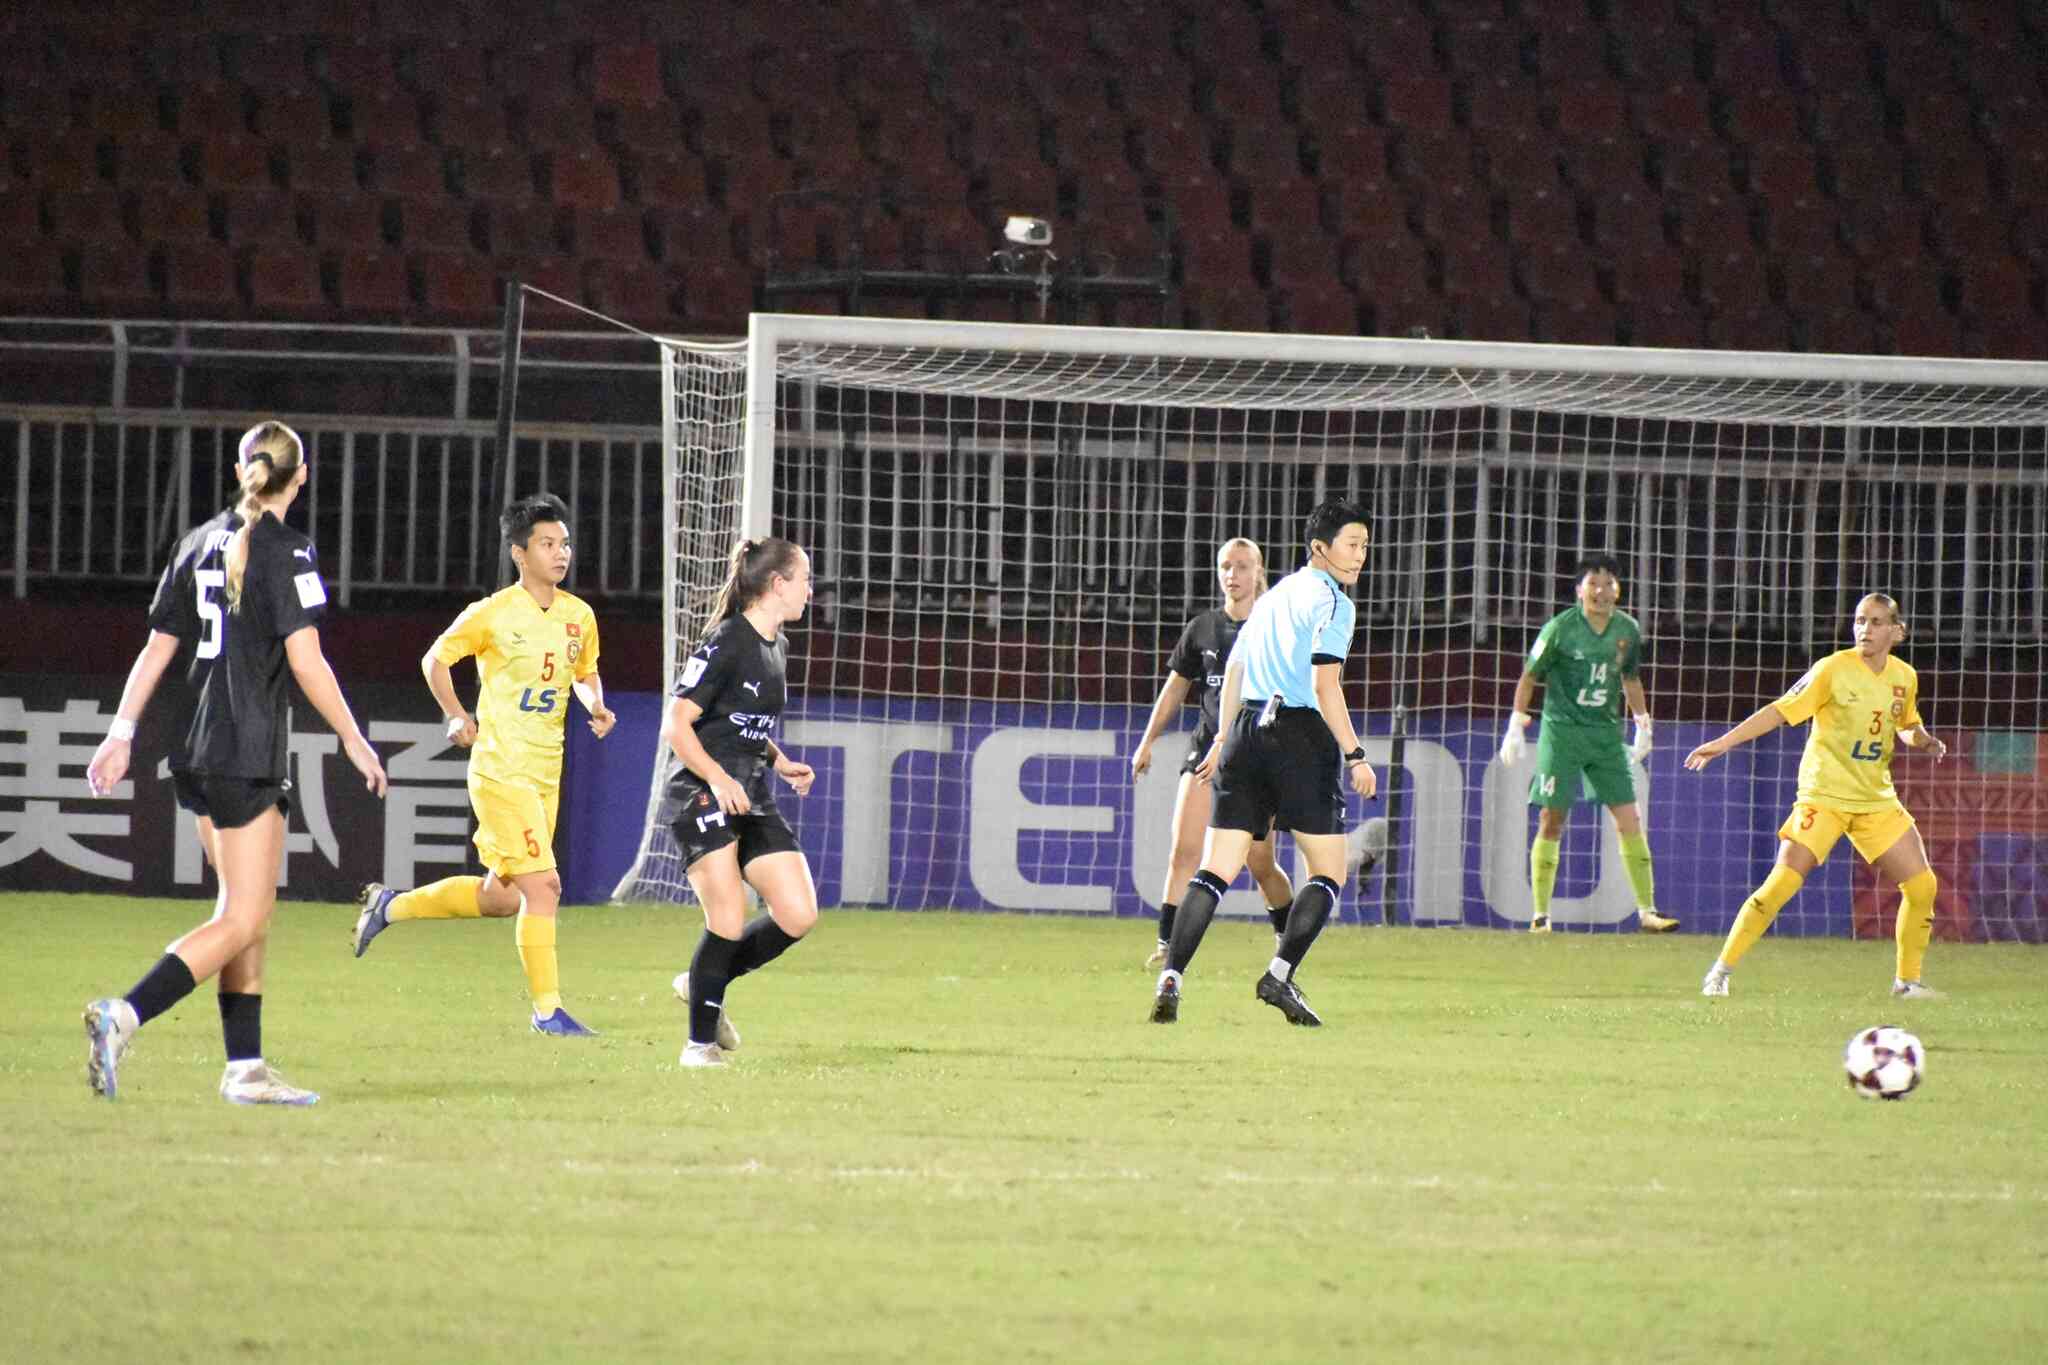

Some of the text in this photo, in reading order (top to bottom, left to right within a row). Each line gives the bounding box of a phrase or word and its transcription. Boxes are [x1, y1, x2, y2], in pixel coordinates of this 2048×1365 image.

[194, 569, 226, 660] 5
[540, 651, 555, 682] 5
[1588, 661, 1608, 685] 14
[519, 687, 558, 713] LS
[1576, 687, 1608, 707] LS
[1869, 710, 1883, 735] 3
[1851, 740, 1883, 761] LS
[1539, 773, 1556, 797] 14
[1800, 807, 1819, 831] 3
[523, 828, 541, 859] 5
